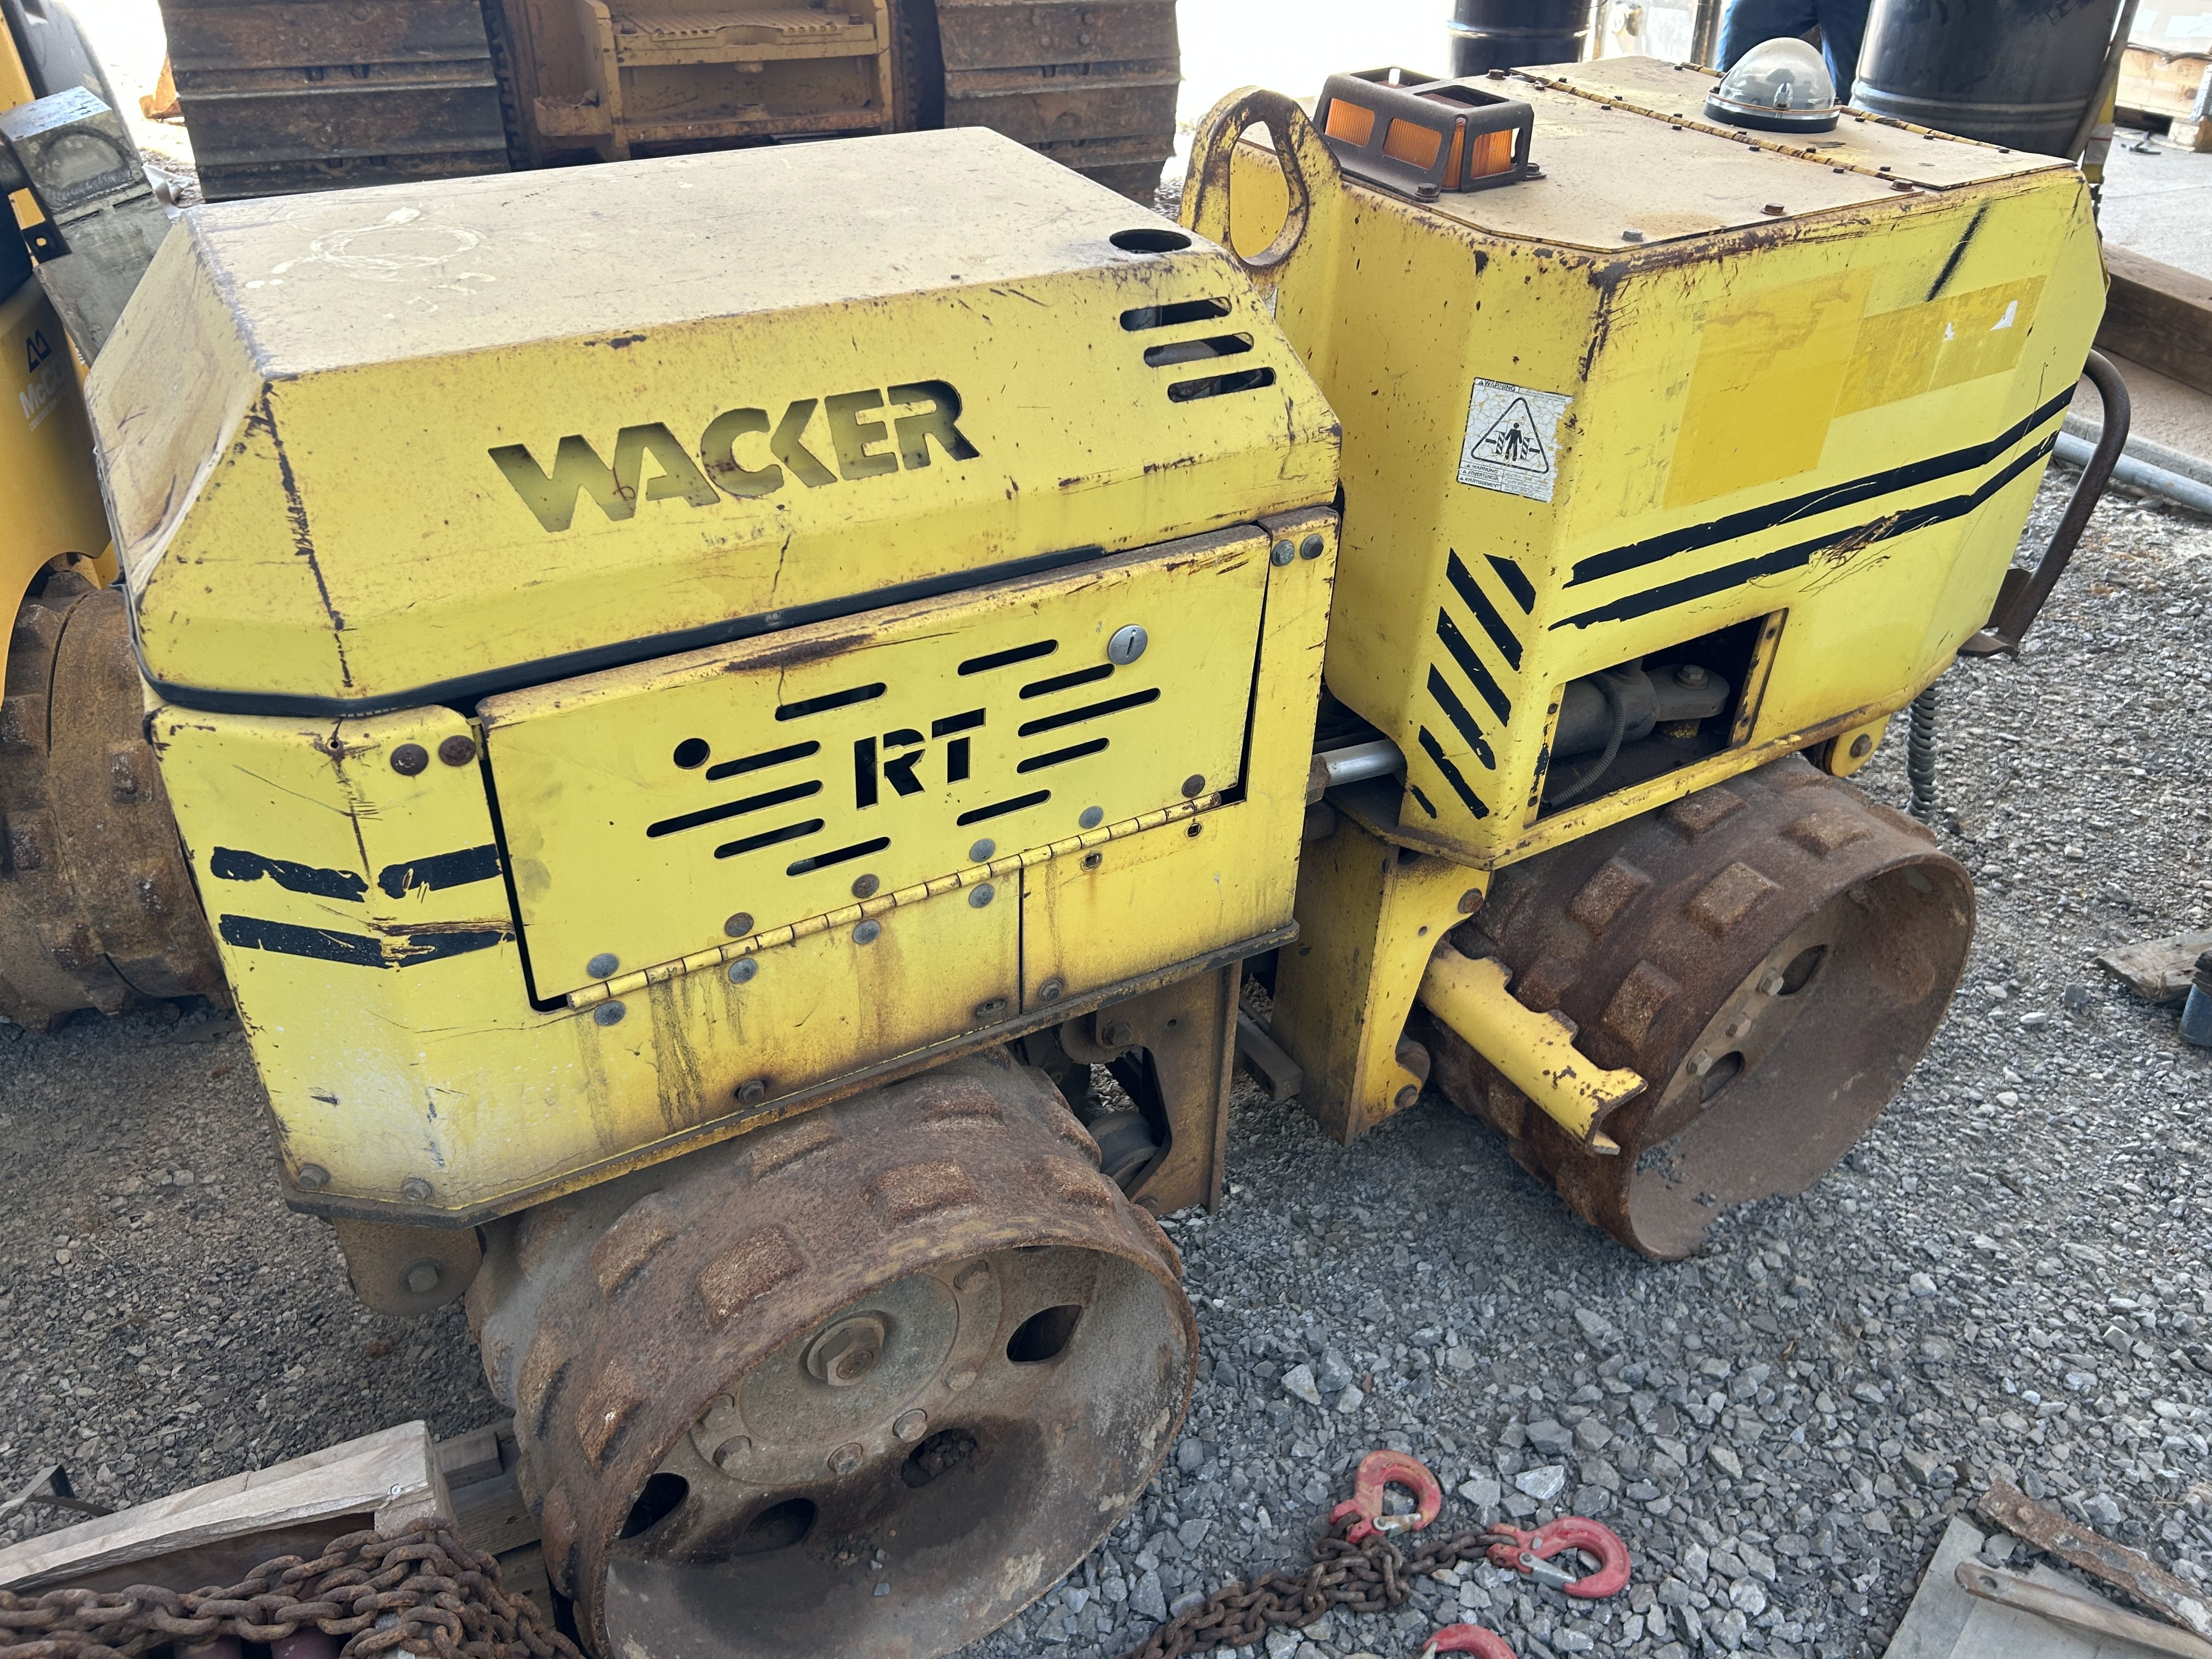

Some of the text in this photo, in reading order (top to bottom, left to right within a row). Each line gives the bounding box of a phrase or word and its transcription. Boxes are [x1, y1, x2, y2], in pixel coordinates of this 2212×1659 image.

[1484, 380, 1516, 392] WARNING
[488, 379, 980, 532] WACKER
[854, 707, 986, 811] RT
